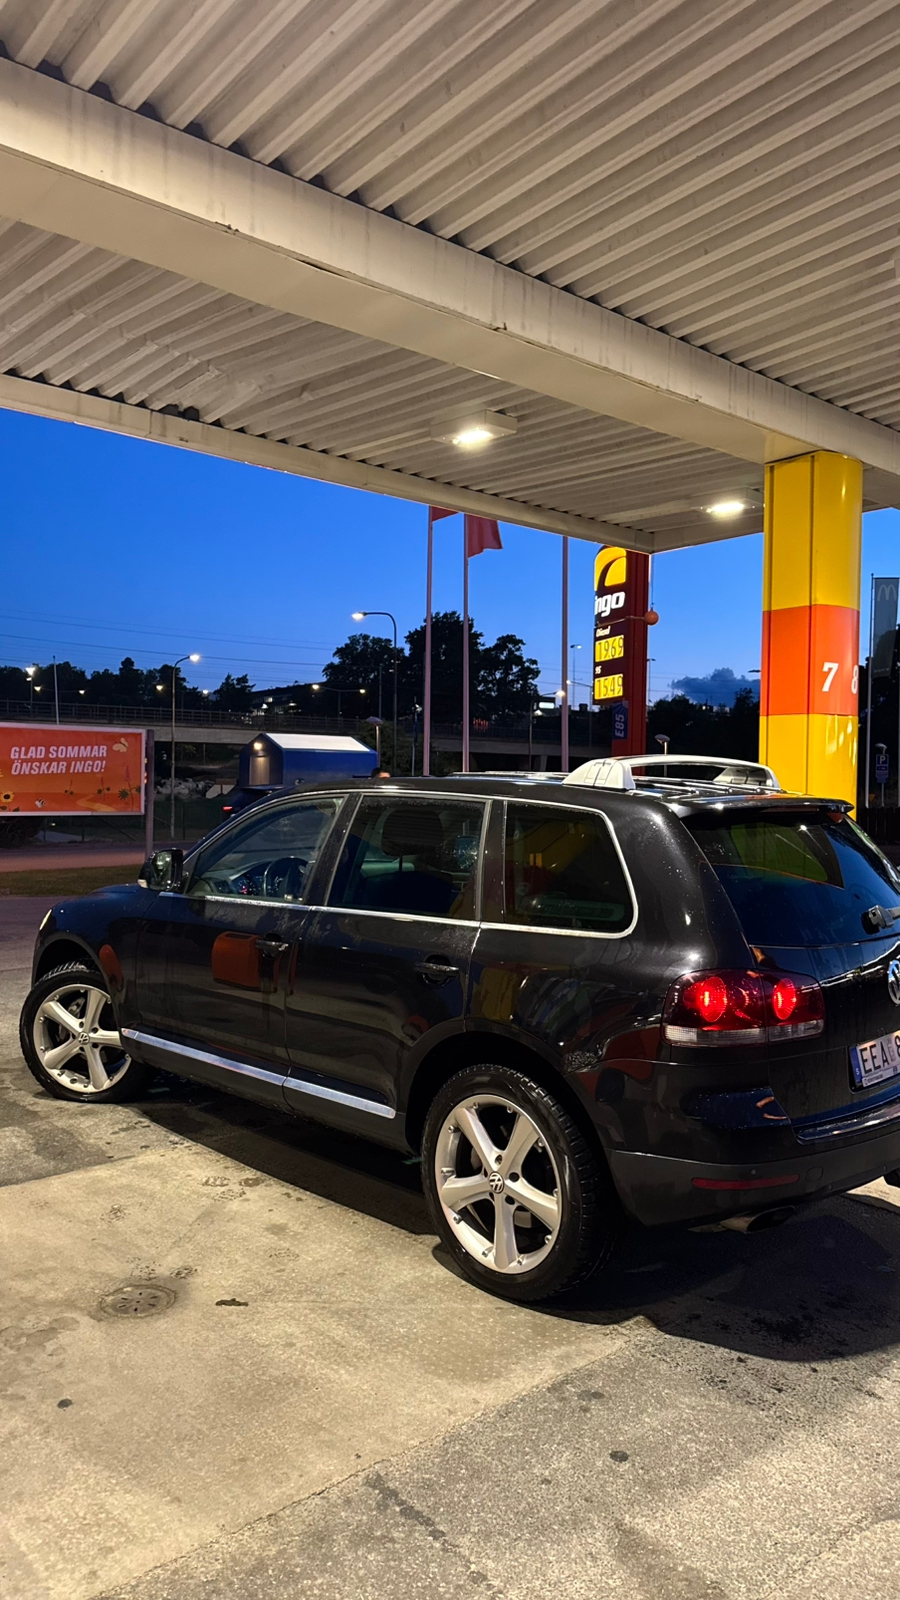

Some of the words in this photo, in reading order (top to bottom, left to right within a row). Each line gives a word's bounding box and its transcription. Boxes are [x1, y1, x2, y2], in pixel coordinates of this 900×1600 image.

[821, 661, 839, 692] 7
[851, 664, 859, 695] 8
[614, 713, 625, 738] E85
[10, 746, 46, 759] GLAD
[49, 745, 108, 758] SOMMAR
[879, 755, 886, 765] P
[11, 760, 68, 775] ÖNSKAR
[69, 760, 107, 773] INGO!
[859, 1041, 890, 1074] EEA
